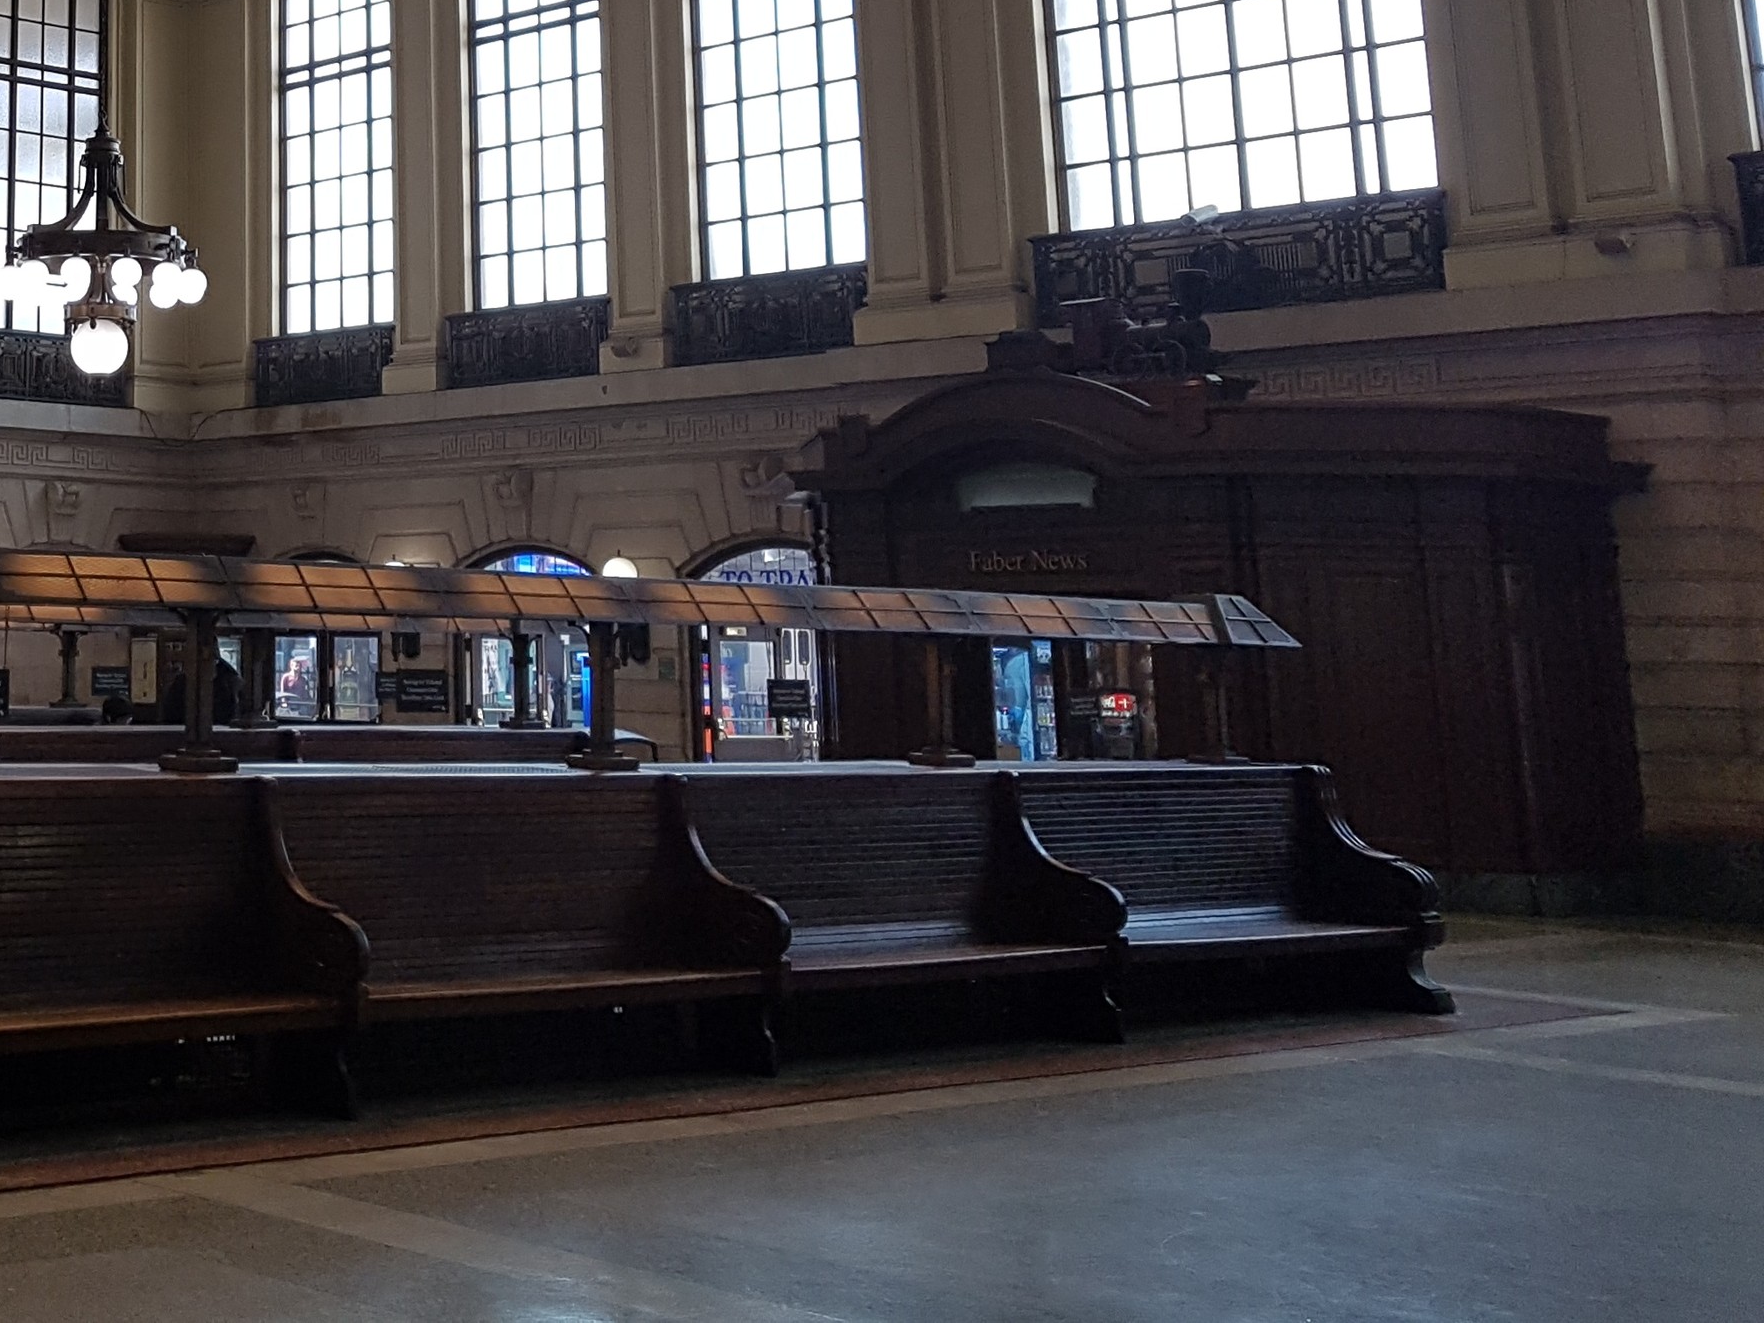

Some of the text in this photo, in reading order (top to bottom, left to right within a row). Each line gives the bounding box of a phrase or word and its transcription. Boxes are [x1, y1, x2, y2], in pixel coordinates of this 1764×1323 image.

[970, 549, 1088, 571] Faber News
[760, 569, 813, 586] TRA
